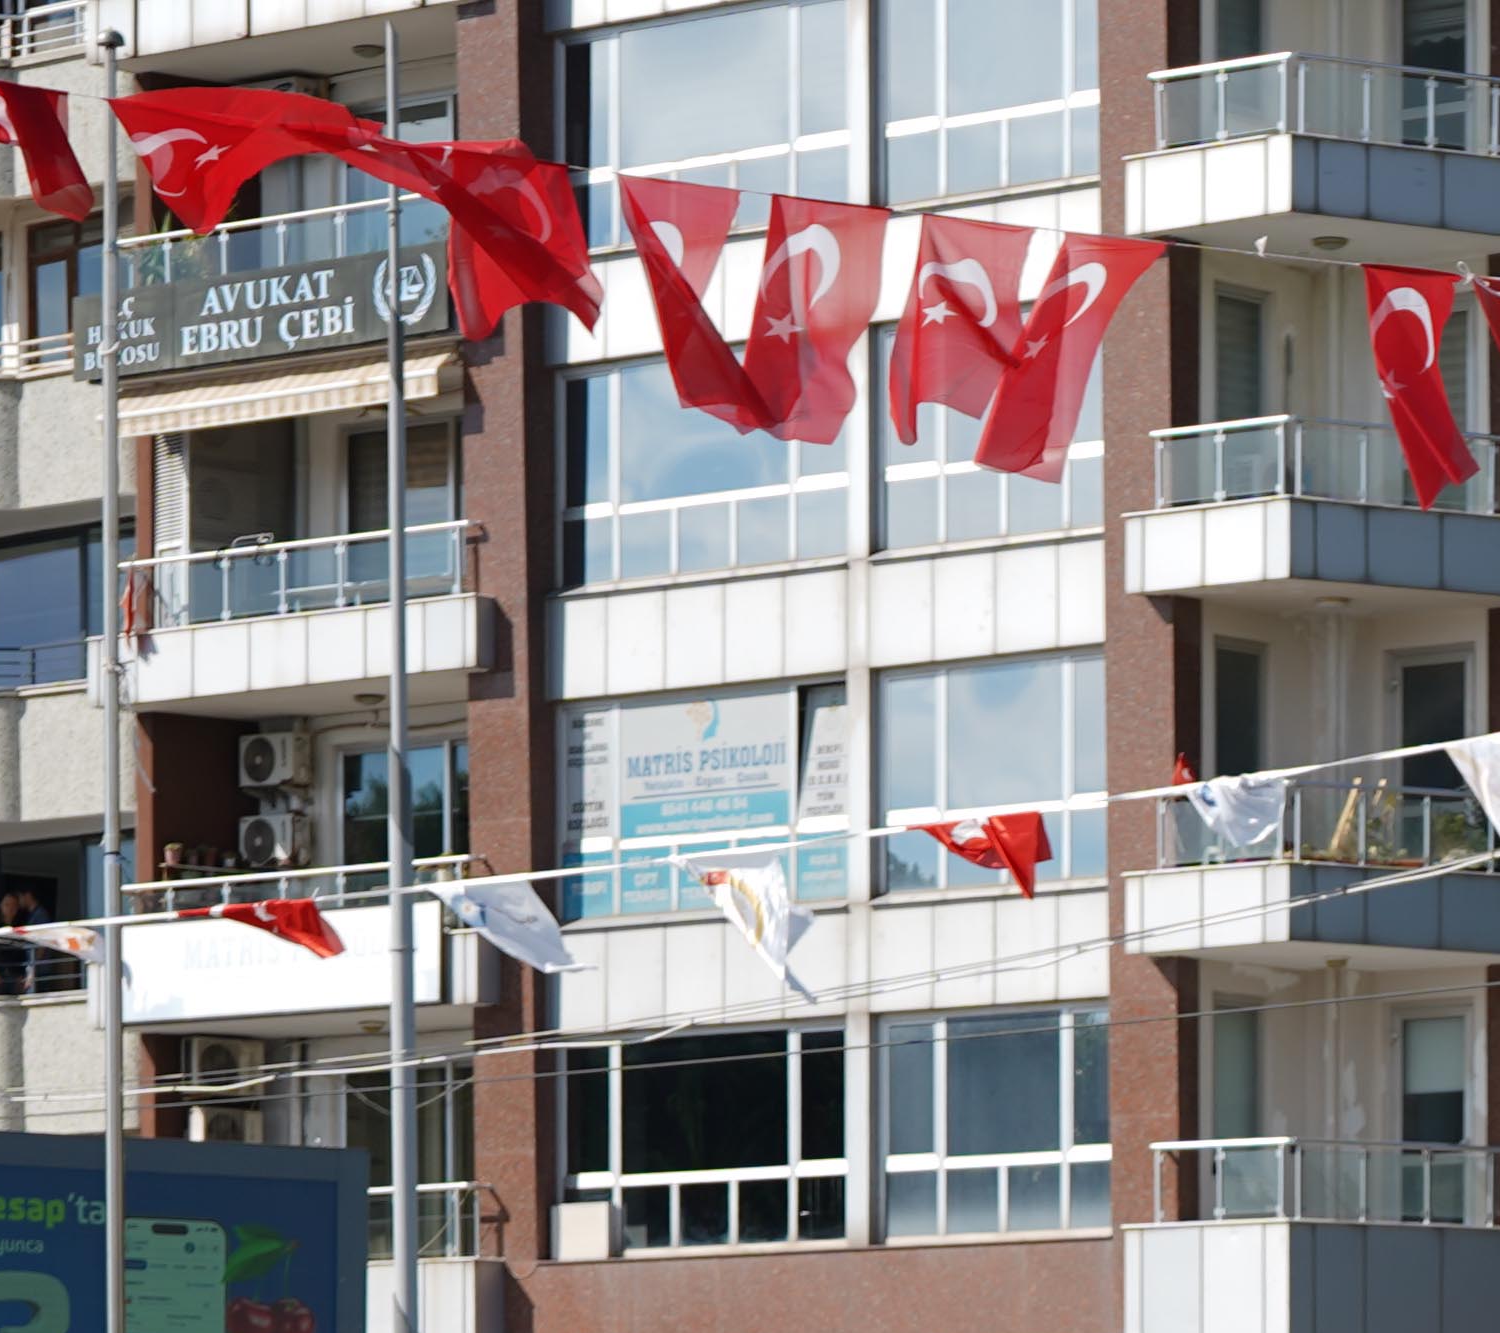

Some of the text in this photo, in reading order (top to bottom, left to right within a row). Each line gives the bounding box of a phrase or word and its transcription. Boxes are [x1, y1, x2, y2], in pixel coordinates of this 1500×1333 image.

[199, 268, 335, 317] AVUKAT
[180, 296, 356, 357] EBRU ÇEBİ
[626, 746, 693, 779] MATRİS
